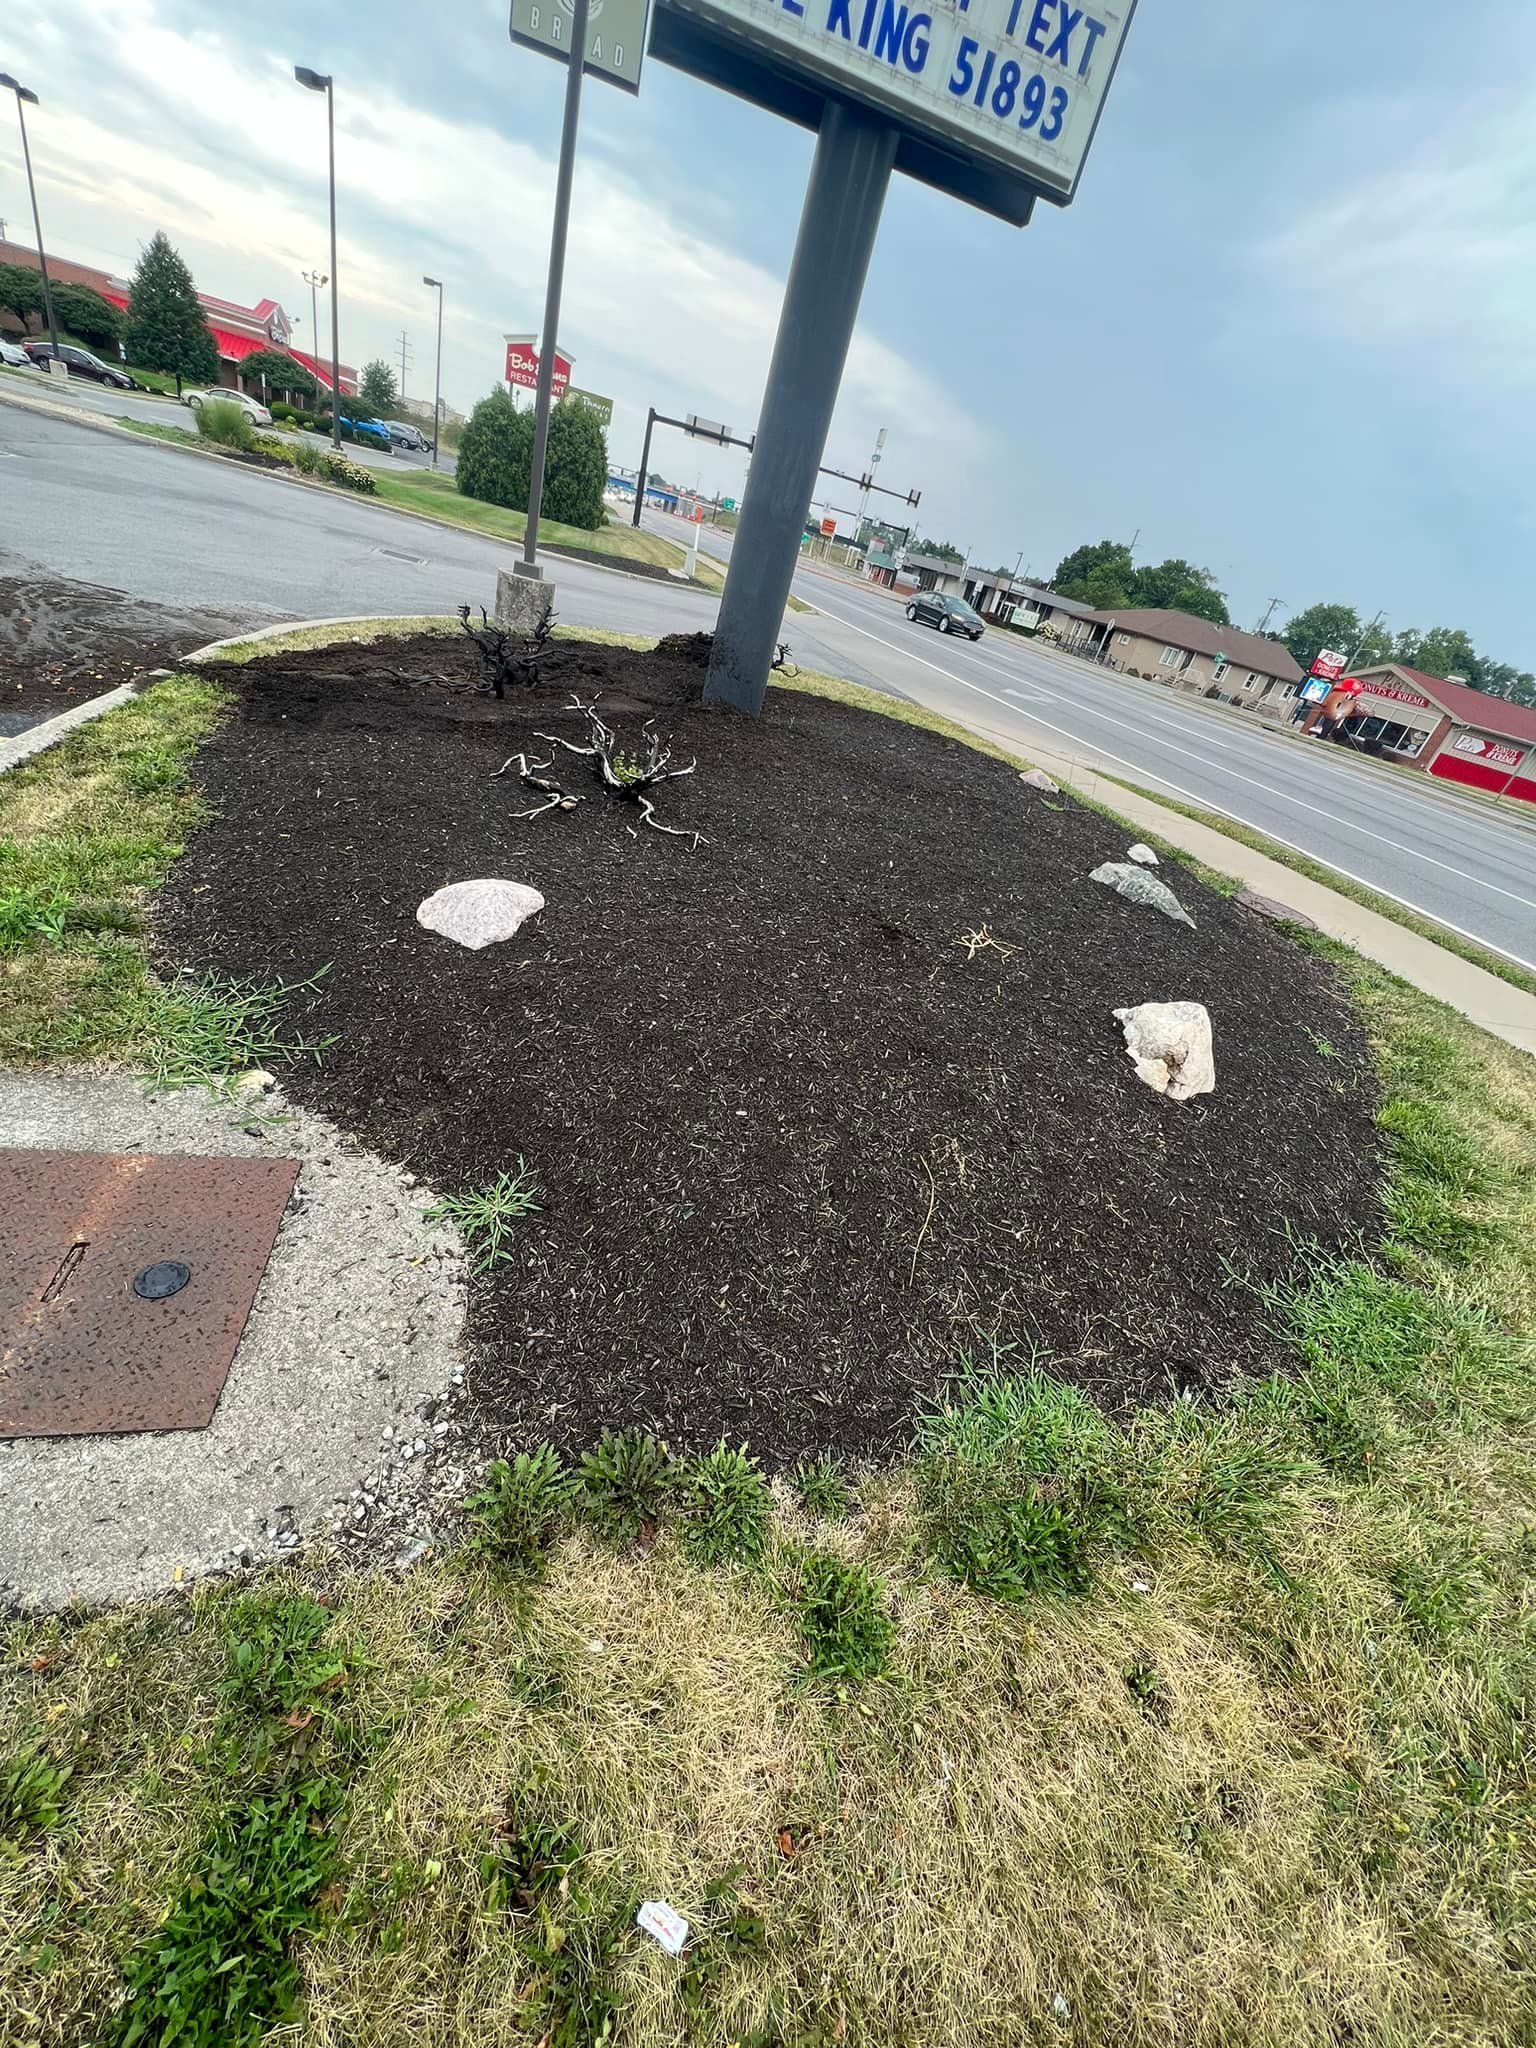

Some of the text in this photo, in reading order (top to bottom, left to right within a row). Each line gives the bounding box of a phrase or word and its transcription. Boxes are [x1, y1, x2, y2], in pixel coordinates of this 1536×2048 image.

[530, 6, 624, 66] BRAD
[826, 0, 1069, 141] KING 51893
[509, 352, 535, 372] Bob
[510, 371, 564, 393] RESTANT
[1316, 662, 1339, 674] DONUTS
[1360, 681, 1425, 706] ONUTS & KREME
[1492, 744, 1519, 757] DONUTS
